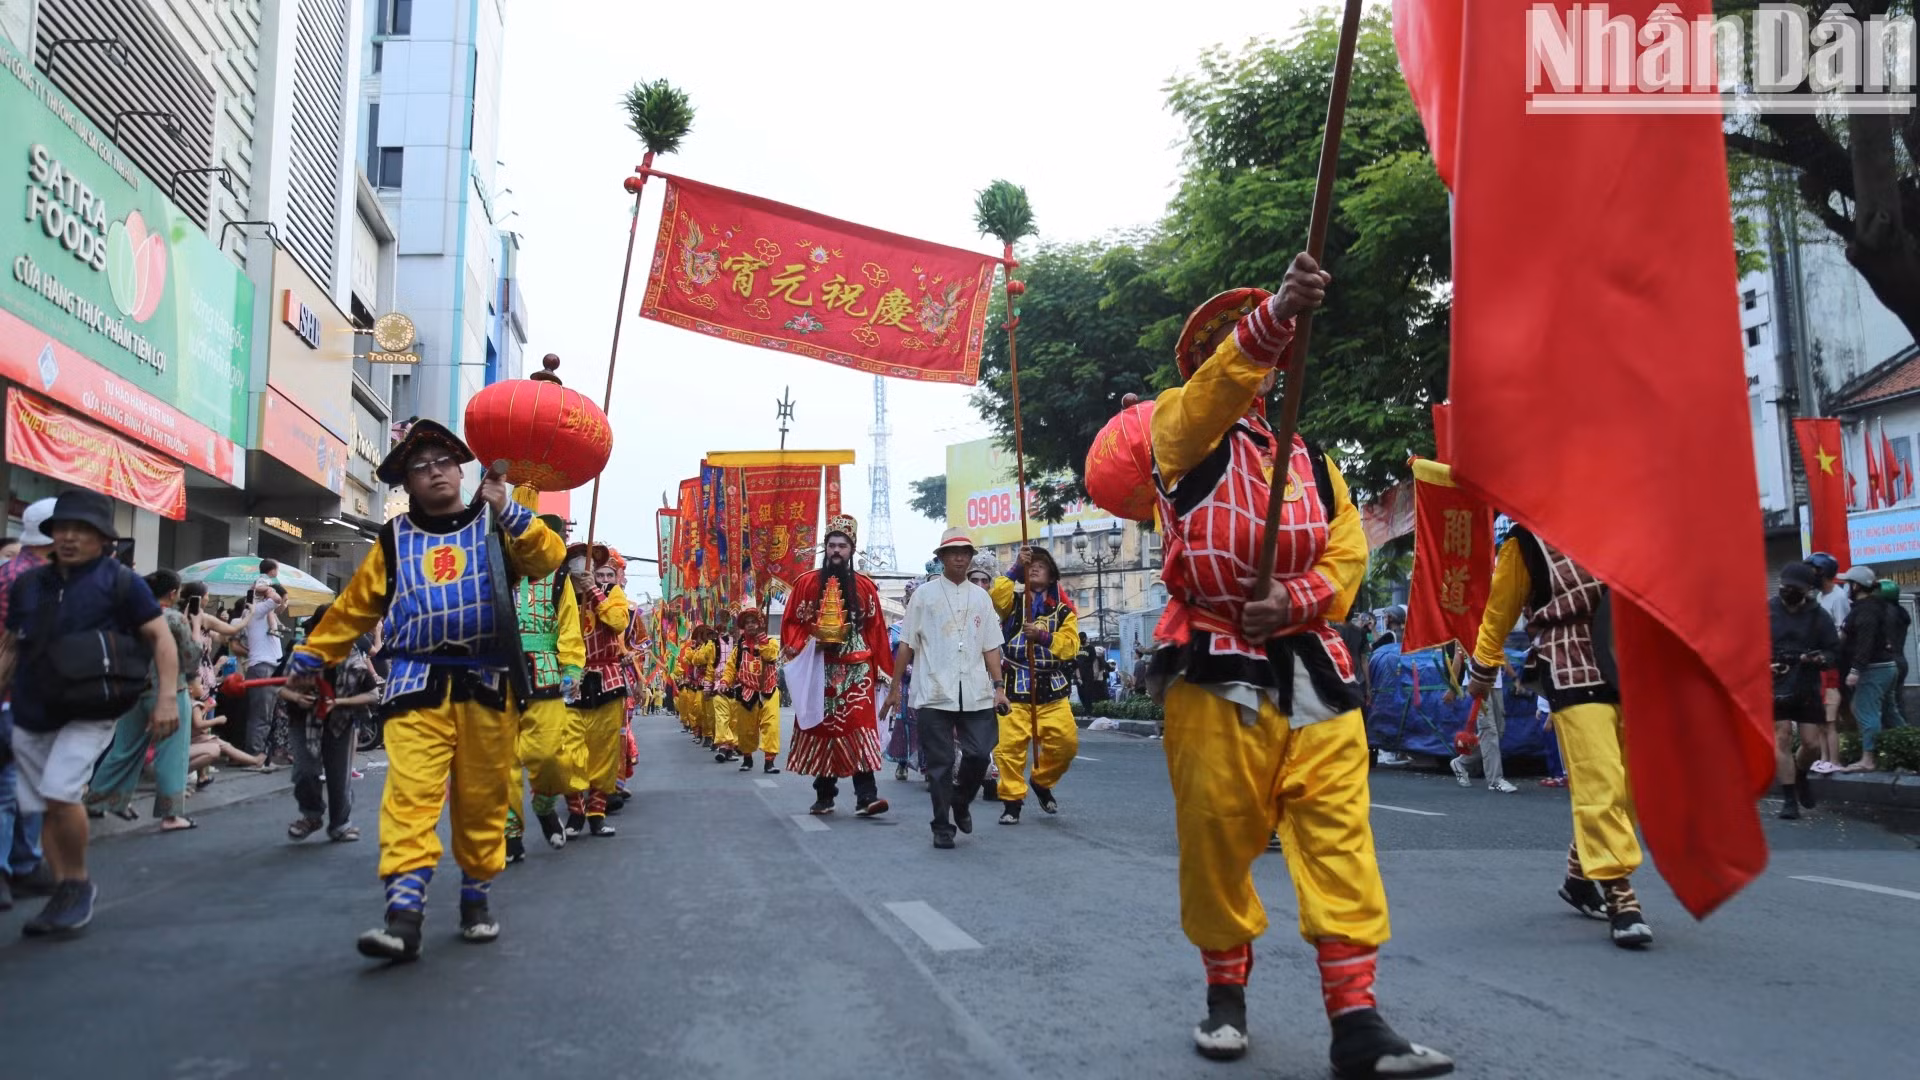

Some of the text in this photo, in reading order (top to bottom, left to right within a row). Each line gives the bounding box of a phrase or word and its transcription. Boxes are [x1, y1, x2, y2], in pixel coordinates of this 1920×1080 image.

[26, 185, 107, 271] FOODS
[28, 144, 107, 235] SATRA
[14, 254, 41, 292] CỬA
[42, 273, 75, 313] HÀNG
[76, 295, 104, 333] THỰC
[104, 316, 132, 350] PHẨM
[132, 334, 152, 364] TIỆN
[152, 347, 166, 375] LỢI
[83, 389, 99, 412] CỬA
[100, 400, 123, 424] HÀNG
[124, 411, 141, 433] BÌNH
[433, 546, 458, 582] 勇
